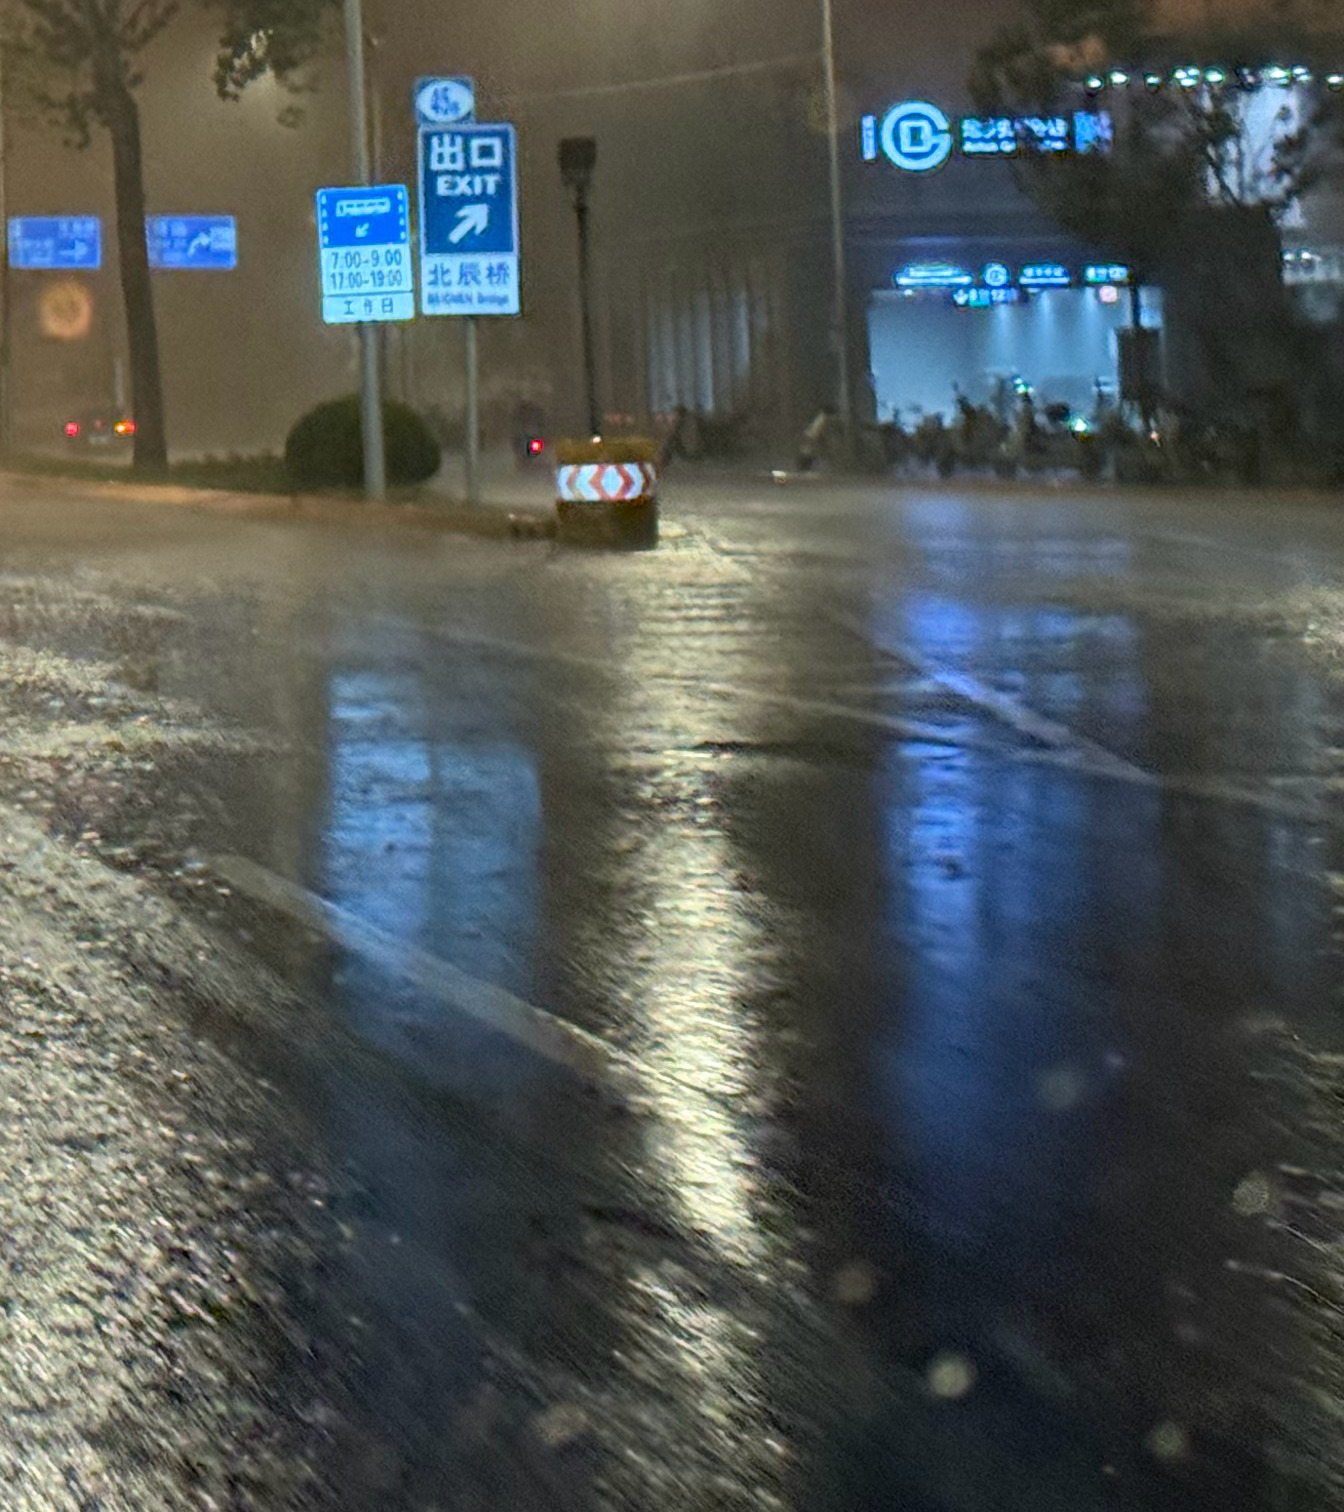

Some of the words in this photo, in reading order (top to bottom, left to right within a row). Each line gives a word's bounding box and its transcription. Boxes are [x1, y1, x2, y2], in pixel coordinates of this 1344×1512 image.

[429, 134, 502, 171] 出口
[435, 175, 500, 197] EXIT
[427, 262, 510, 287] 北辰桥
